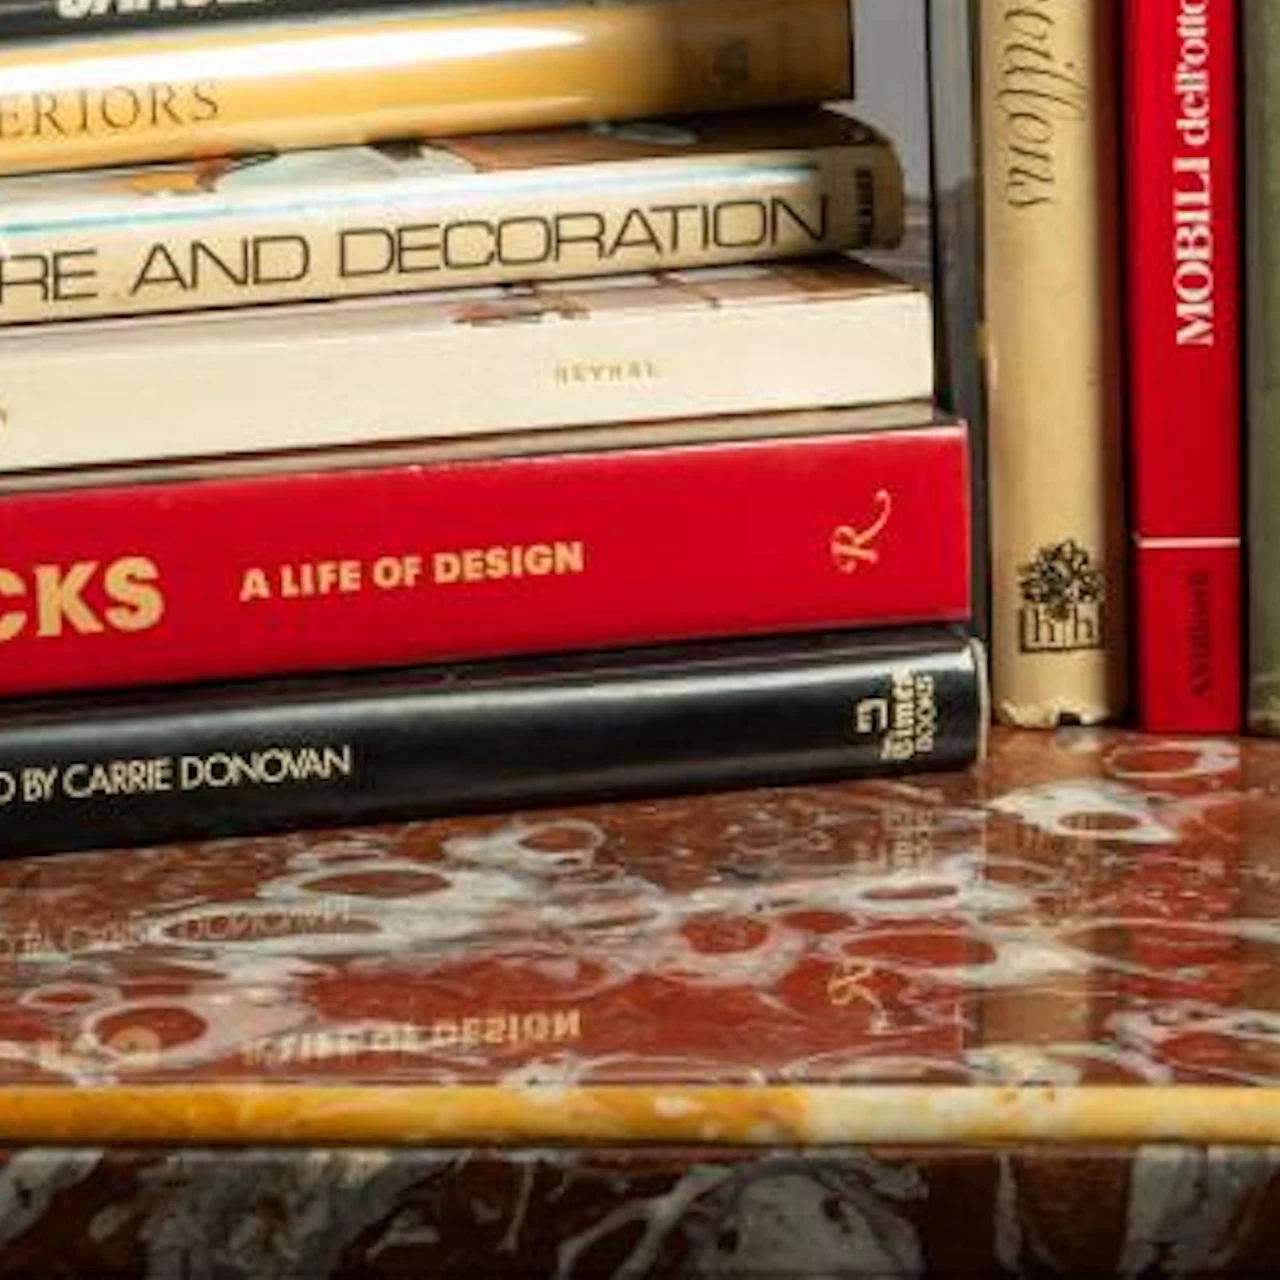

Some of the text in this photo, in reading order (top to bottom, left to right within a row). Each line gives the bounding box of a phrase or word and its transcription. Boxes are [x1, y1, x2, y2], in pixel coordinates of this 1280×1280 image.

[130, 235, 311, 296] AND
[338, 196, 828, 278] DECORATION
[1173, 156, 1214, 347] MOBILI
[239, 568, 271, 602] A
[280, 560, 362, 598] LIFE
[373, 556, 423, 589] OF
[434, 541, 584, 584] DESIGN
[830, 489, 893, 574] R
[22, 767, 56, 803] BY
[62, 758, 173, 800] CARRIE
[180, 744, 352, 791] DONOVAN
